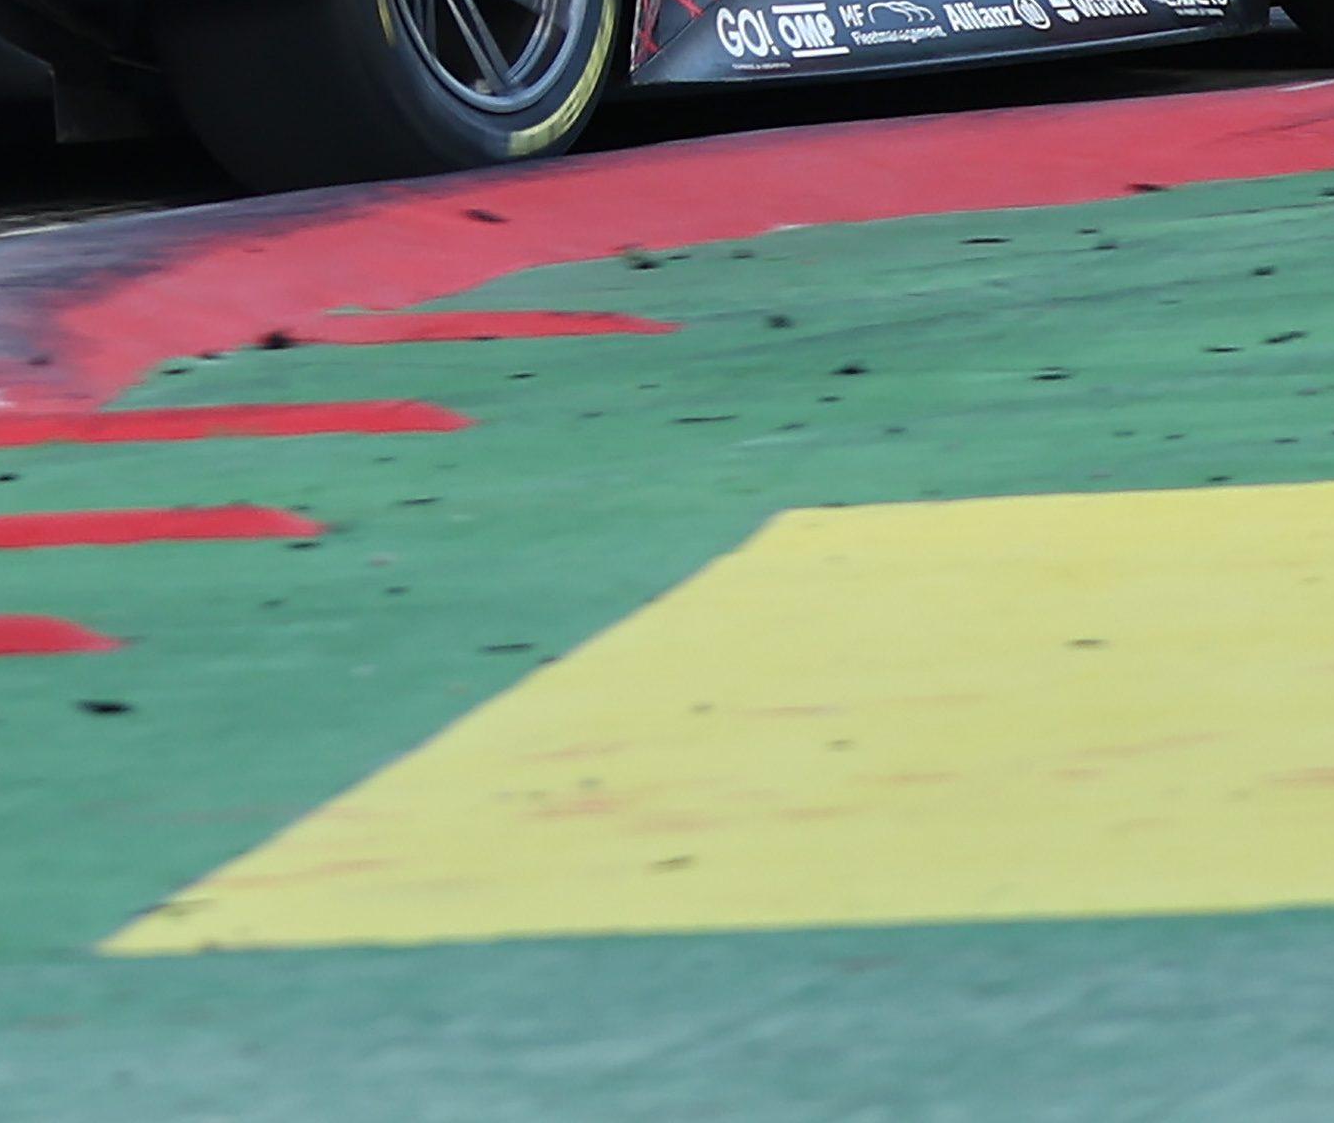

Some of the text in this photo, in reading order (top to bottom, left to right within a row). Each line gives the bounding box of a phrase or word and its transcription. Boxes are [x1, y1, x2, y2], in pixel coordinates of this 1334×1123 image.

[717, 7, 781, 58] GO!
[777, 12, 836, 50] OMP
[942, 0, 1022, 32] Allianz
